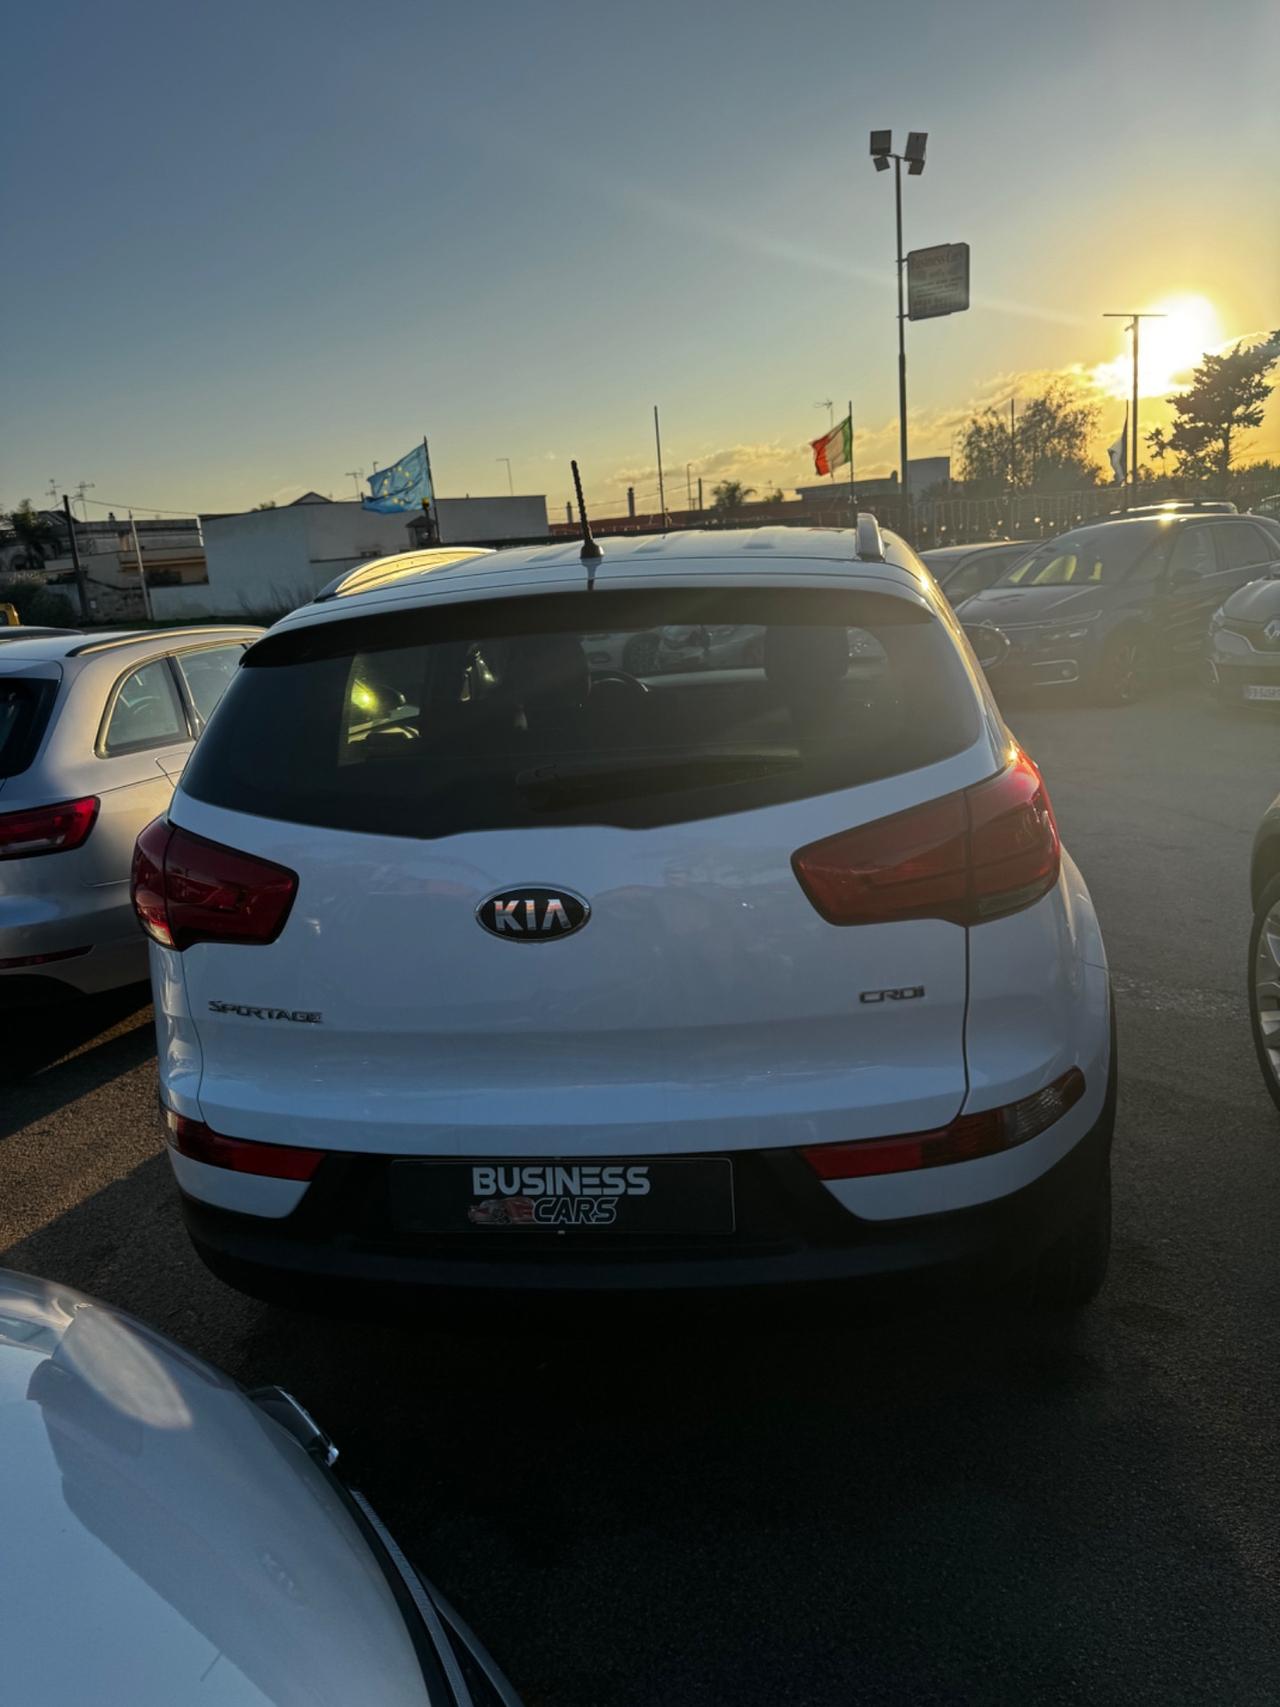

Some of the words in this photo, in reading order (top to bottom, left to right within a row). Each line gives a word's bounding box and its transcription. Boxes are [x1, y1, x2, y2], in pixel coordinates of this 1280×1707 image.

[493, 898, 573, 931] KIA
[208, 1000, 323, 1024] SPORTAGE
[472, 1166, 651, 1196] BUSINESS
[532, 1197, 619, 1225] CARS
